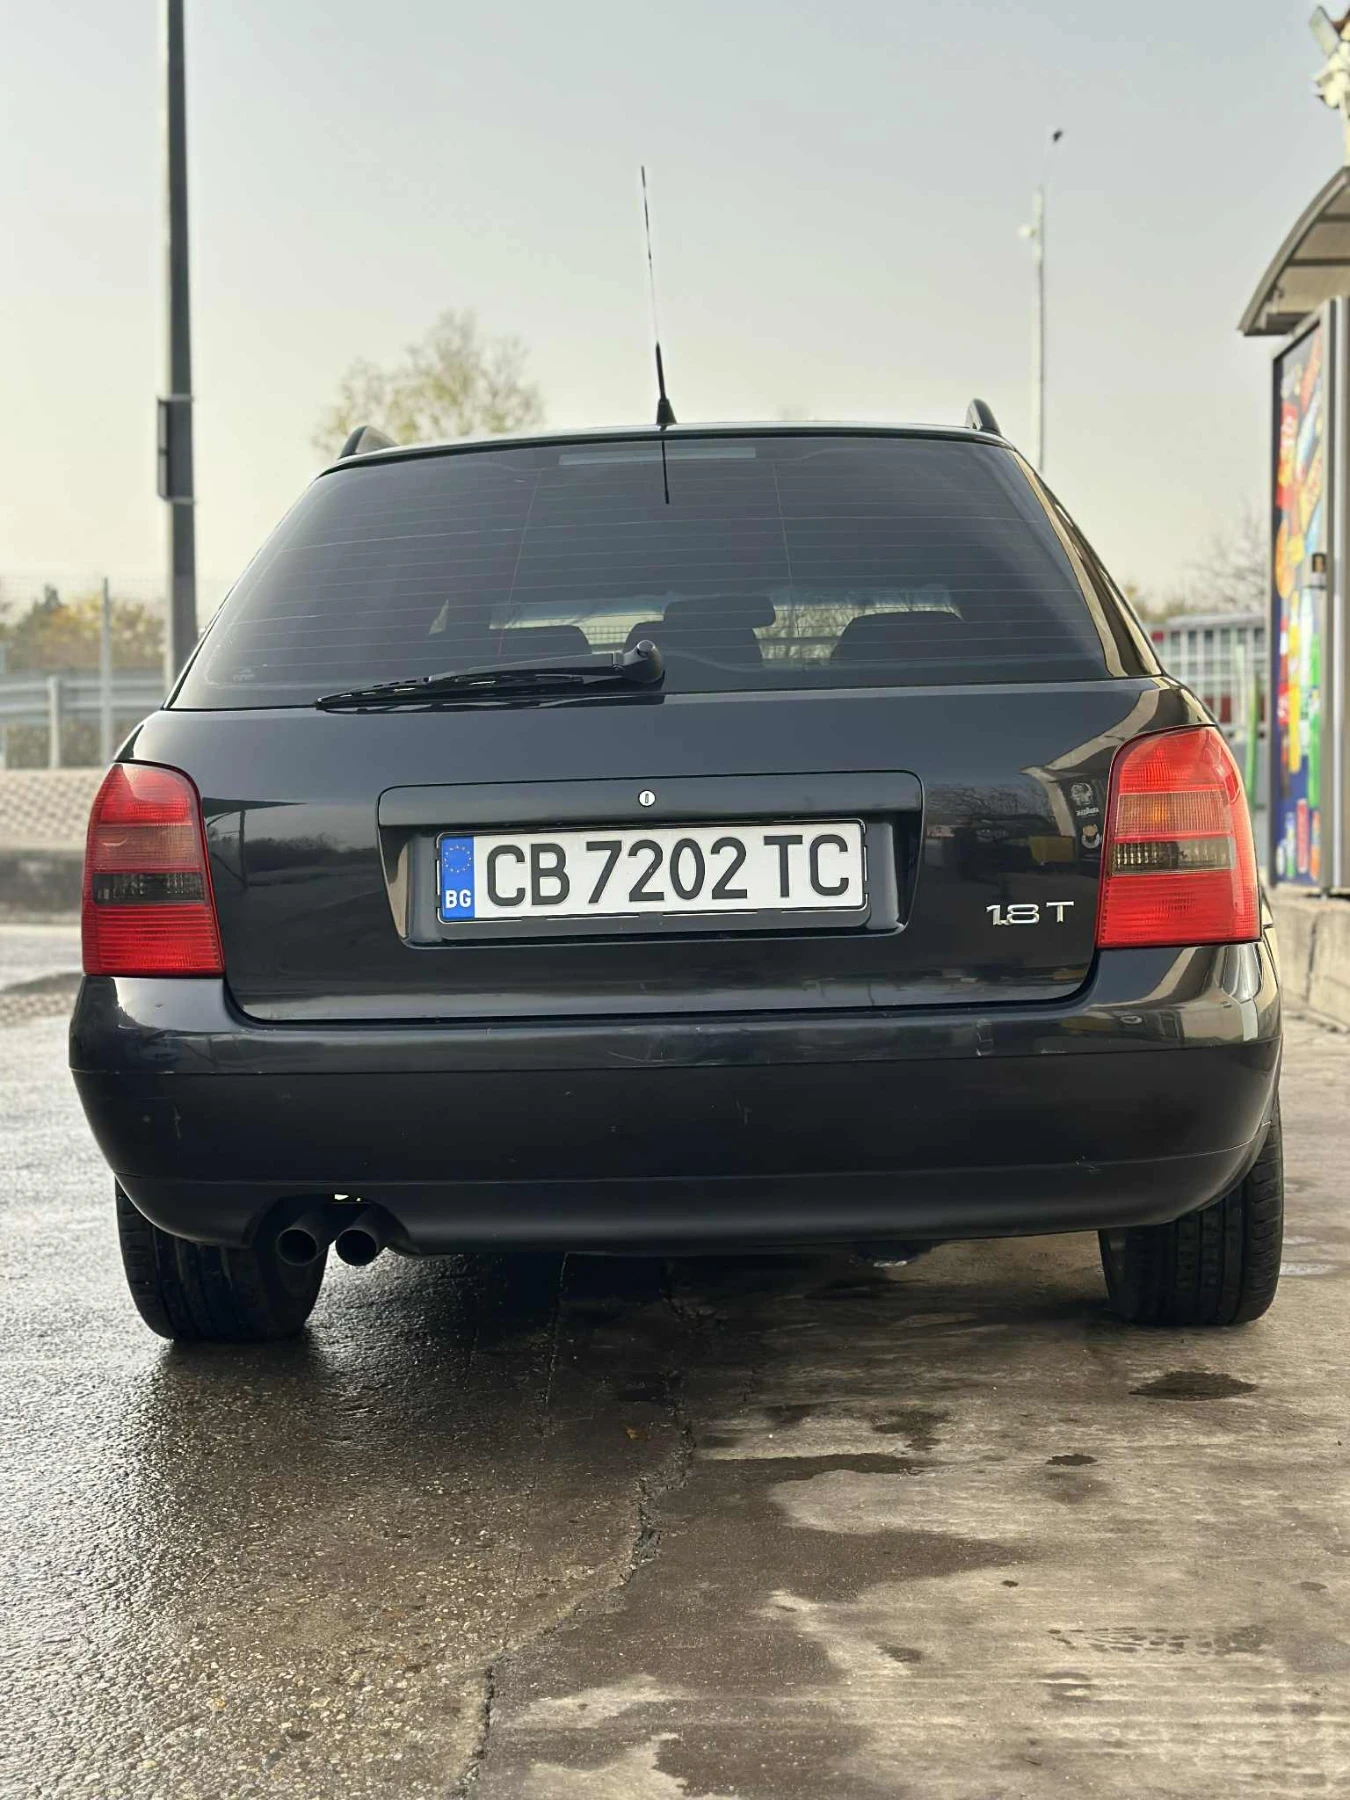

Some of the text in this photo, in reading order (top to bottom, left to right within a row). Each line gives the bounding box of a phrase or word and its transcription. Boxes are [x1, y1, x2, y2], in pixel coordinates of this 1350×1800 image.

[487, 834, 849, 907] CB 7202 TC
[445, 889, 472, 908] BG
[1046, 901, 1074, 922] T
